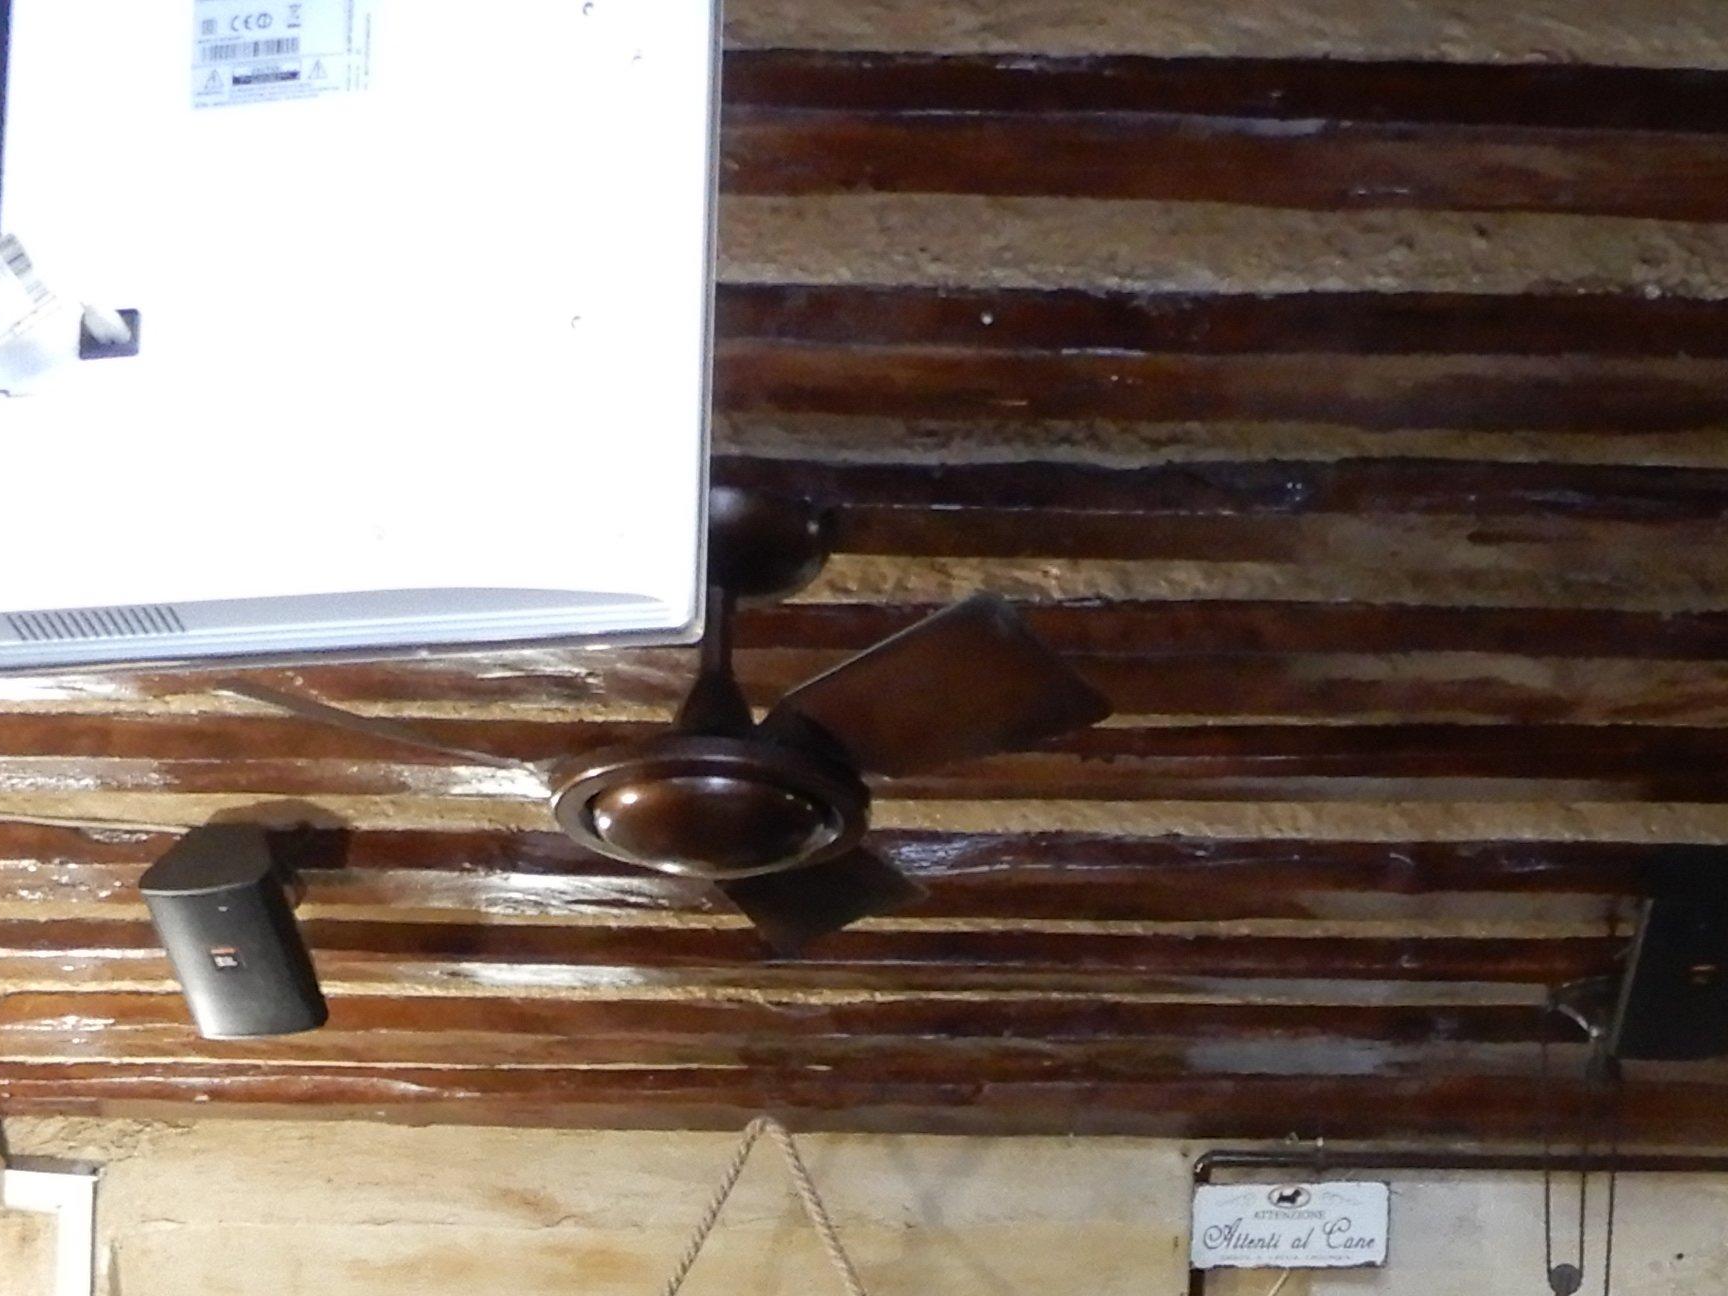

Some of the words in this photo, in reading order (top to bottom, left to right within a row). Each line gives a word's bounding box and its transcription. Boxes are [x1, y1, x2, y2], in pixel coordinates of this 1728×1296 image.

[1203, 1217, 1280, 1250] Attenti
[1291, 1227, 1314, 1250] al
[1323, 1216, 1375, 1250] Cane
